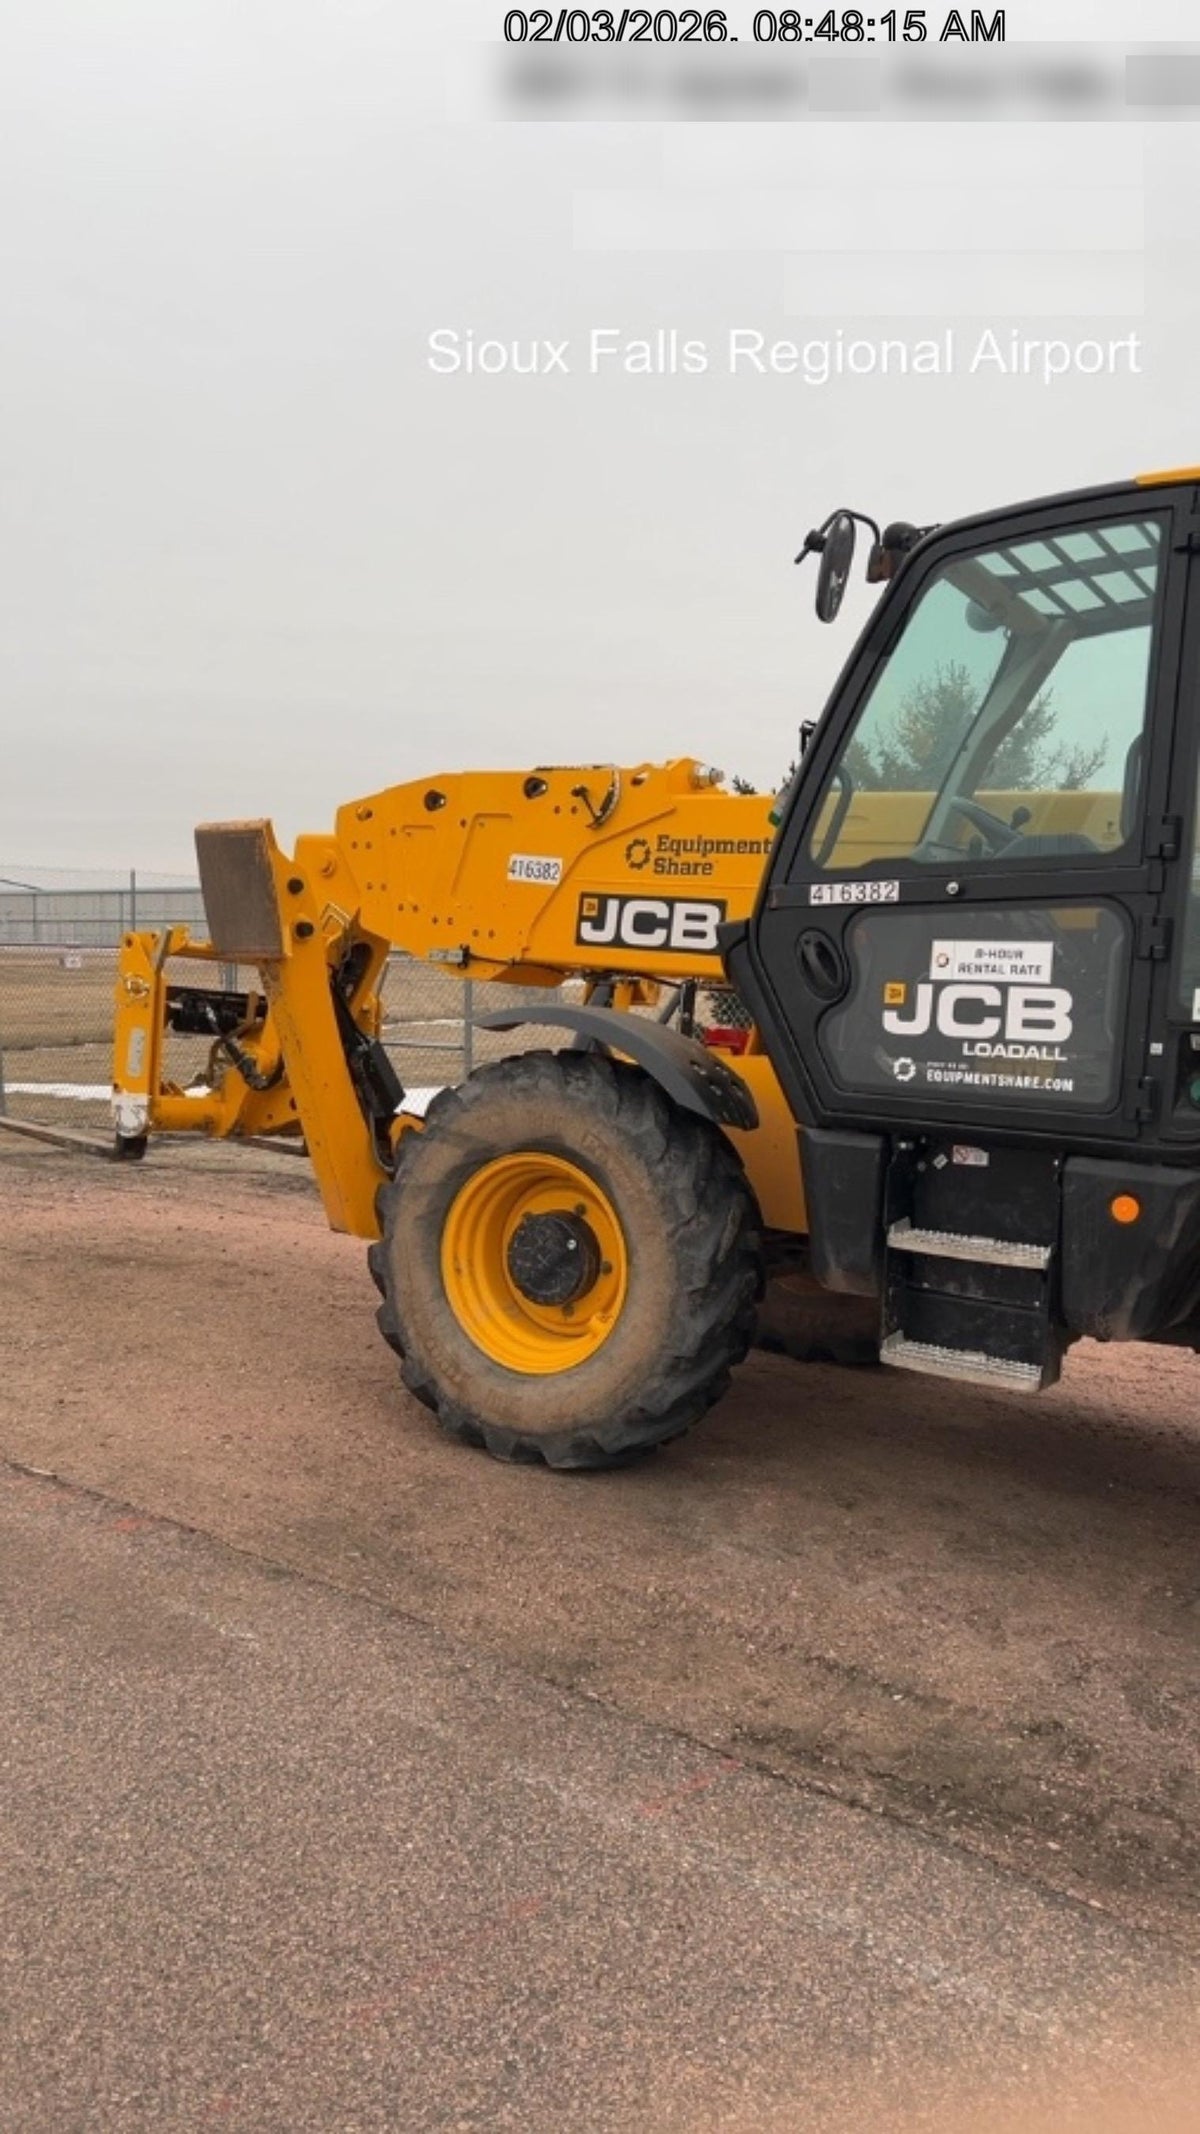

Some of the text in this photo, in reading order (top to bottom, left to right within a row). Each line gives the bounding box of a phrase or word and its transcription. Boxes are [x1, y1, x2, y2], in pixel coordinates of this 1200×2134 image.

[656, 835, 773, 857] Equipment
[508, 860, 560, 880] 416382
[653, 857, 713, 876] Share
[812, 881, 897, 902] 416382
[579, 898, 722, 950] JCB
[957, 962, 1043, 976] RENTAL RATE
[882, 983, 1073, 1042] JCB
[961, 1041, 1069, 1061] LOADALL
[926, 1069, 1074, 1092] EQUIPMENTSHARE.COM
